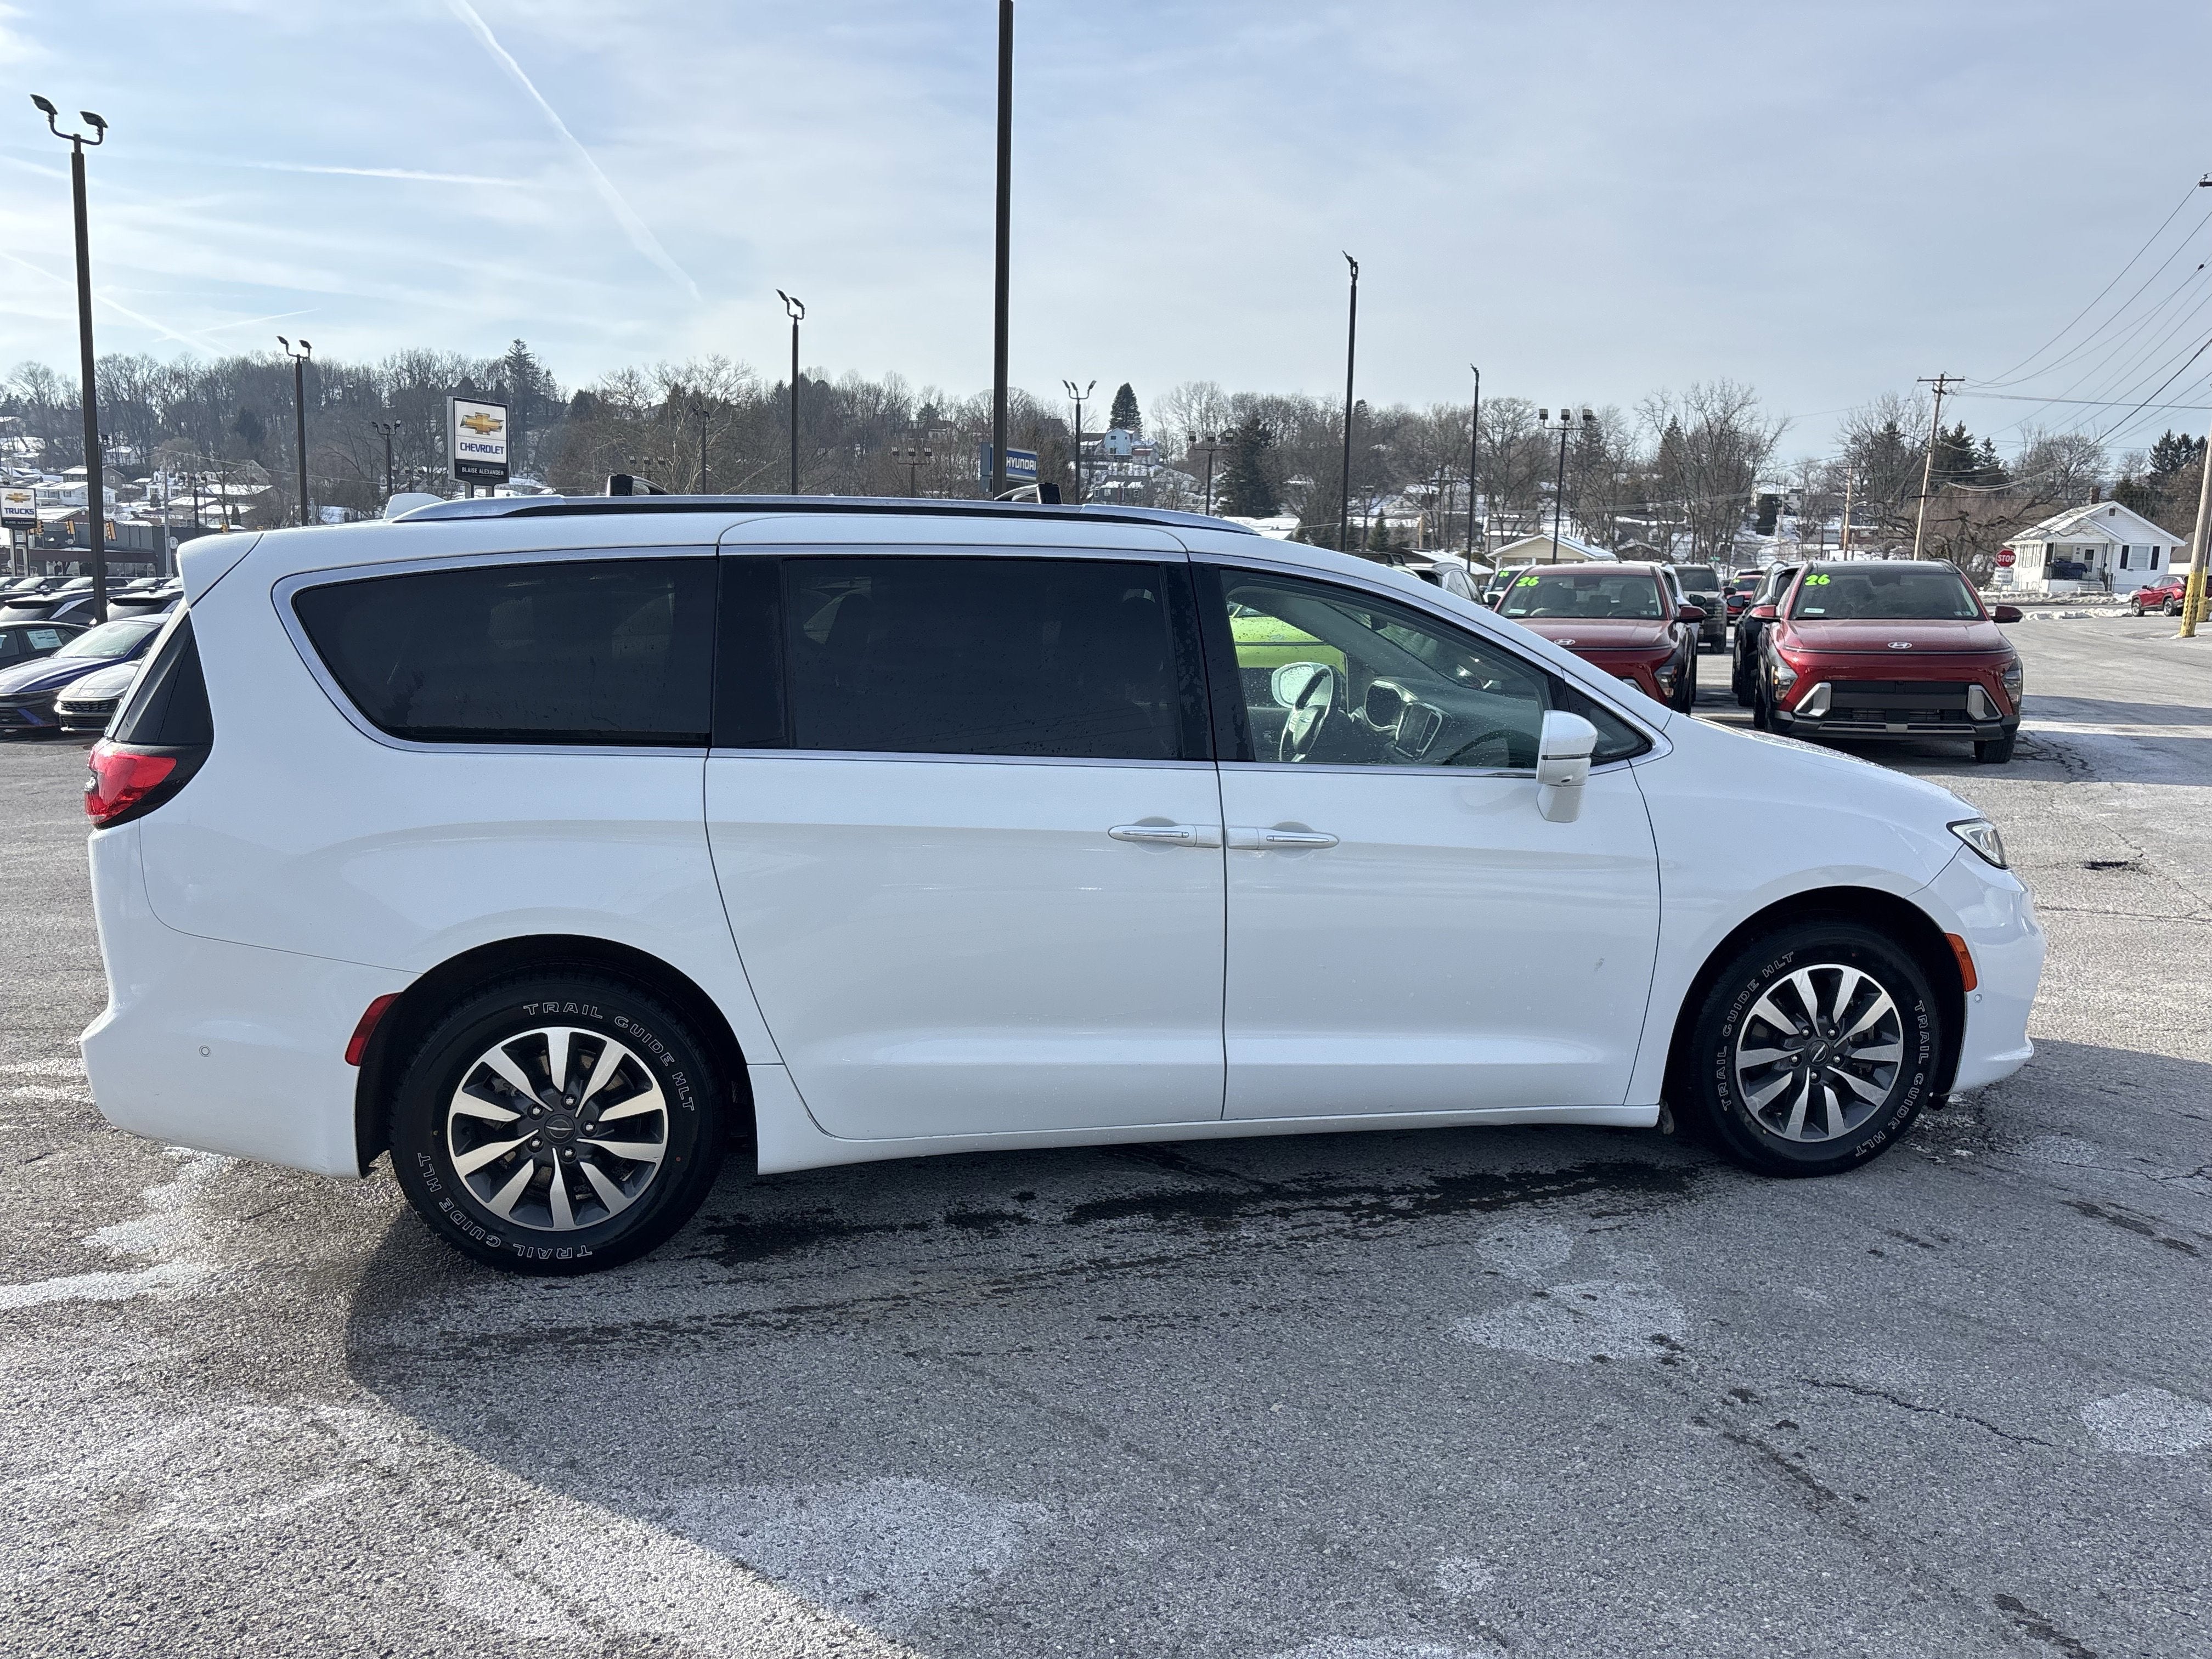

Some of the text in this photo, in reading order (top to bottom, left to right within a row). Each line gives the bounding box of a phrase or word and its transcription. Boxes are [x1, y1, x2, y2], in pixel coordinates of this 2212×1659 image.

[460, 442, 504, 455] CHEVROLET
[1006, 456, 1036, 471] HYUNDAI
[479, 468, 504, 476] ALEXANDER
[1997, 555, 2016, 563] STOP
[1516, 576, 1539, 586] 26
[1805, 574, 1831, 586] 26
[1716, 951, 1795, 1111] TRAIL GUIDE HLT
[523, 1002, 695, 1112] TRAIL GUIDE HLT
[1855, 1000, 1930, 1158] TRAIL GUIDE HLT
[417, 1152, 592, 1260] TRAIL GUIDE HLT
